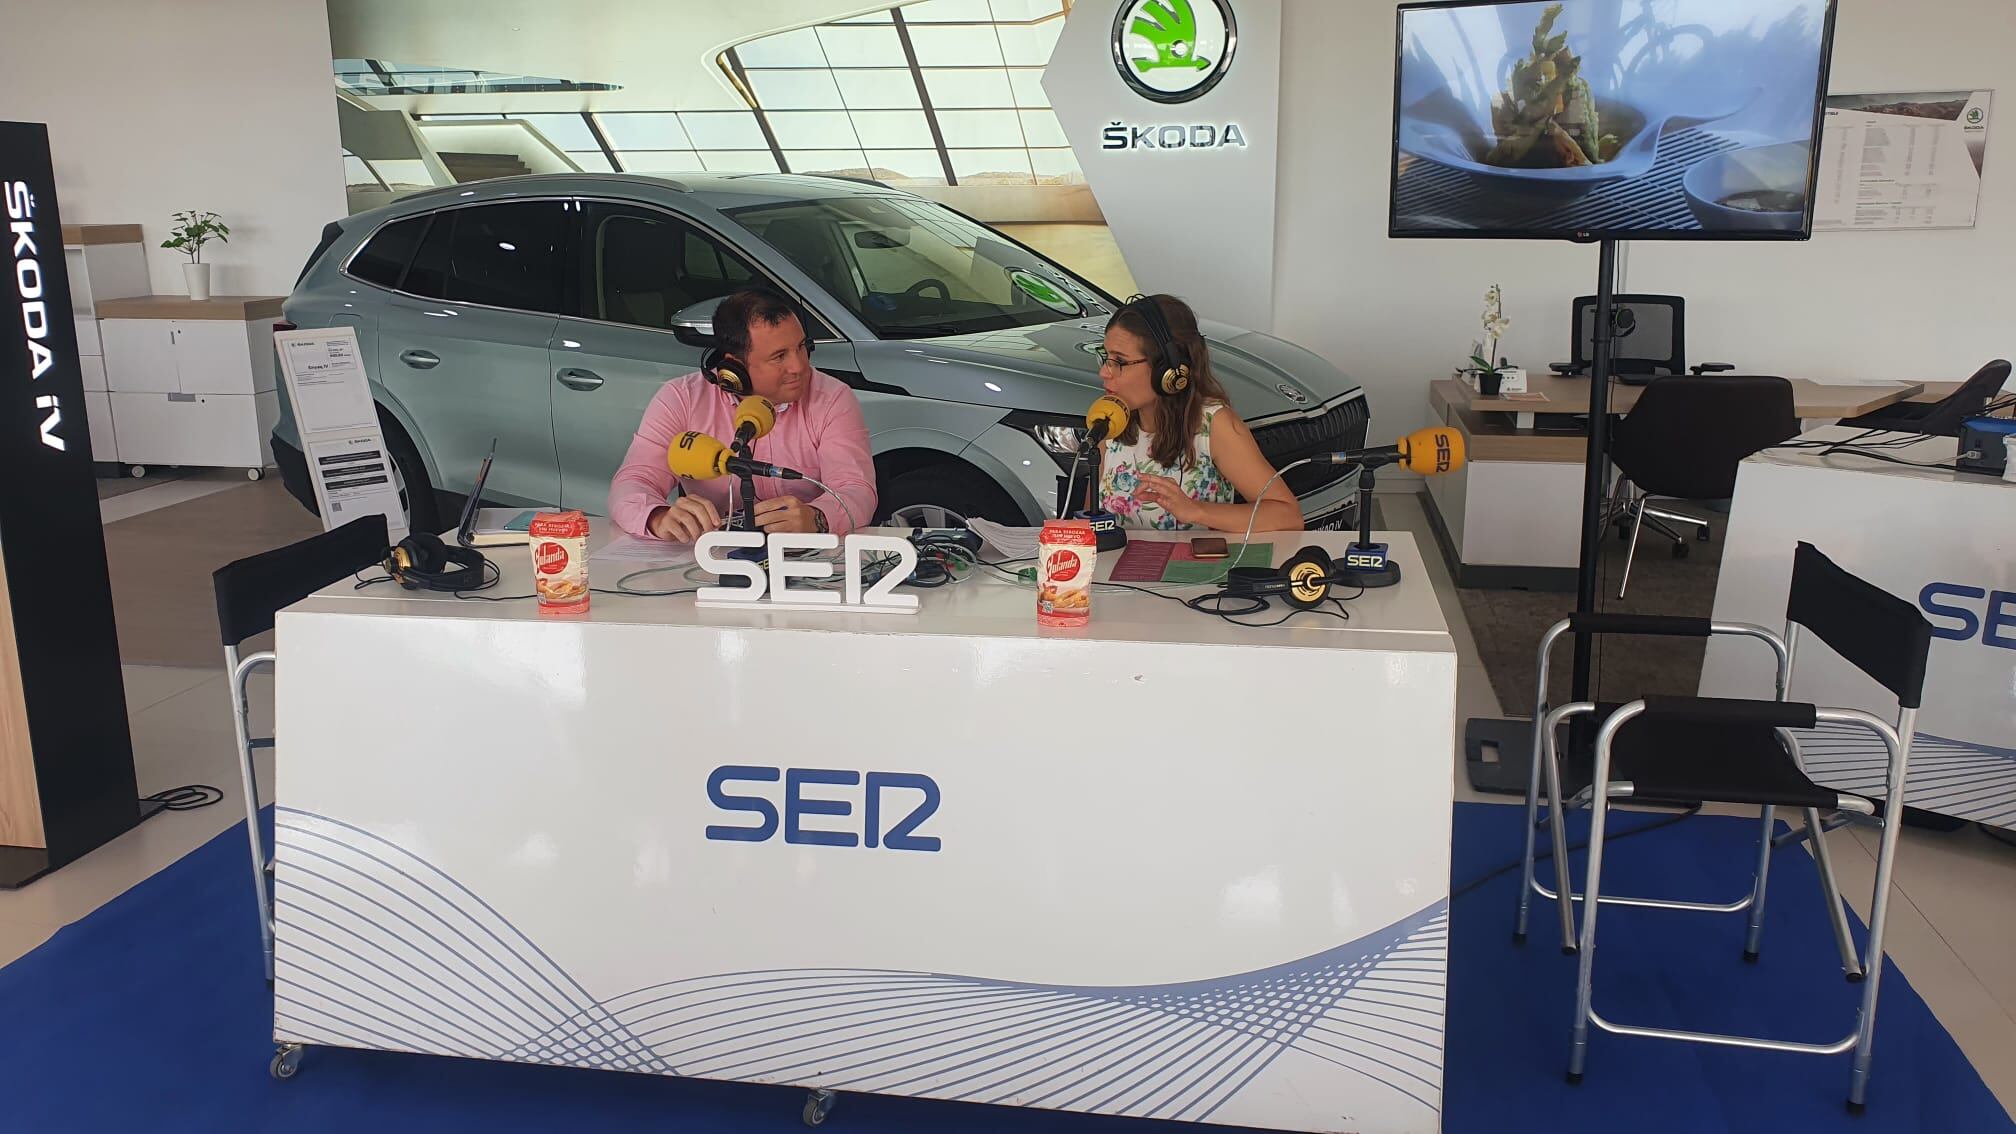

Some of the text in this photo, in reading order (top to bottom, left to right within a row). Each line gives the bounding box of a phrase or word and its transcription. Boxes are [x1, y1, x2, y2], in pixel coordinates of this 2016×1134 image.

[1102, 121, 1247, 150] ŠKODA
[4, 181, 55, 381] ŠKODA
[1434, 433, 1451, 473] SER
[694, 531, 919, 606] SER
[1346, 554, 1383, 568] SER
[1918, 581, 2016, 651] SE
[705, 764, 942, 852] SER
